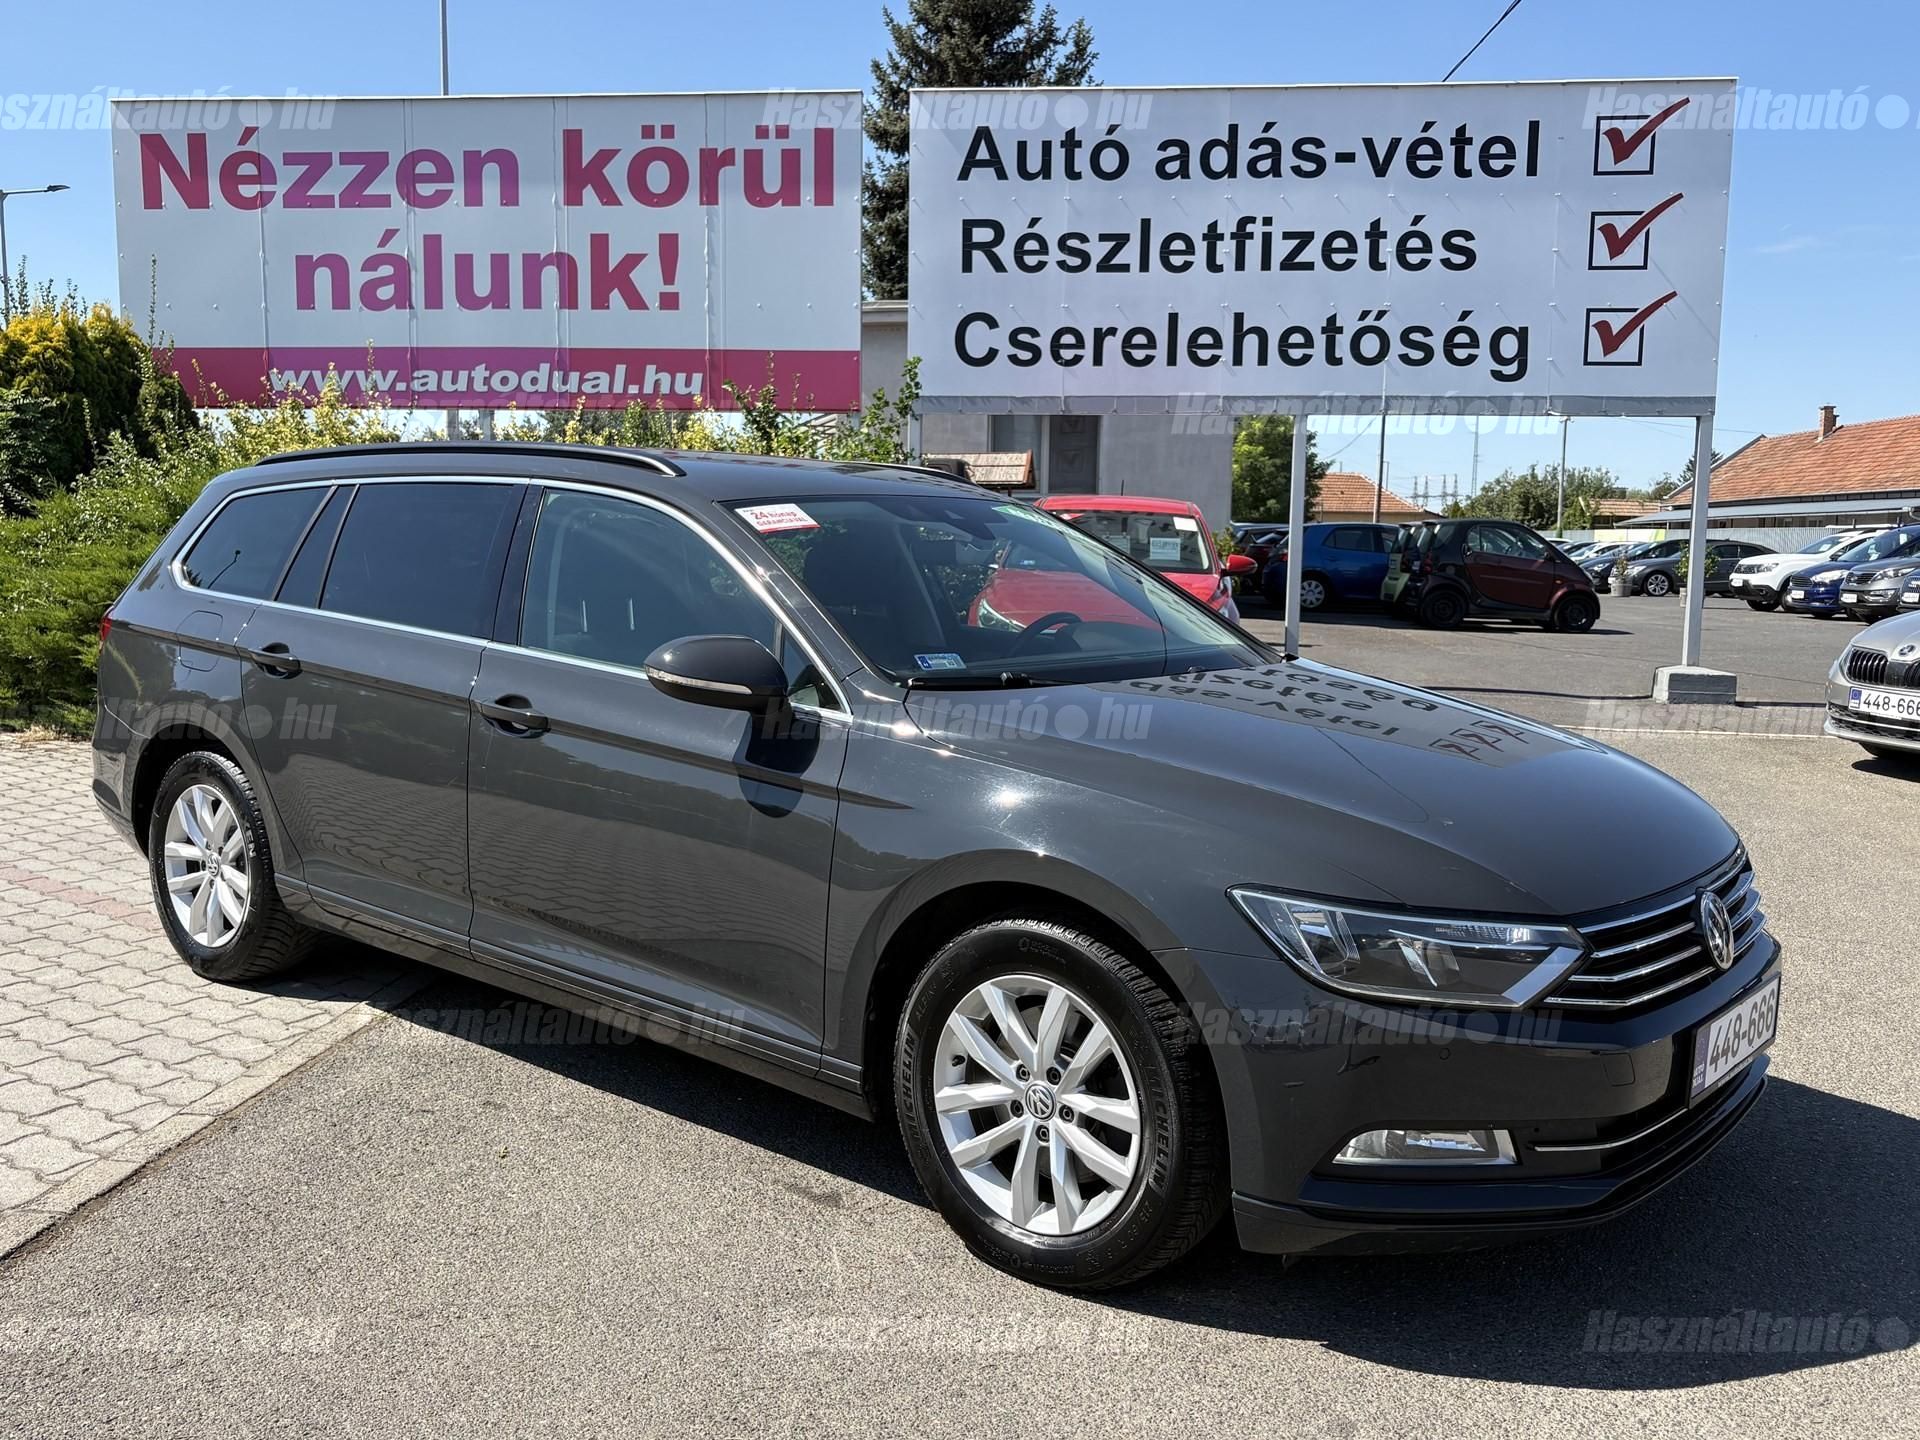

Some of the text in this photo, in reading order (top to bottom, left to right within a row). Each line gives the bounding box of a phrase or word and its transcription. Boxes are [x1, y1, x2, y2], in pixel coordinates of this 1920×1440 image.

[139, 124, 835, 211] Nézzen körül
[957, 120, 1540, 182] Autó adás-vétel
[295, 228, 680, 311] nálunk!
[961, 214, 1477, 274] Részletfizetés
[268, 362, 704, 396] www.autodual.hu
[954, 310, 1529, 383] Cserelehetőség
[1709, 988, 1775, 1073] 448-666
